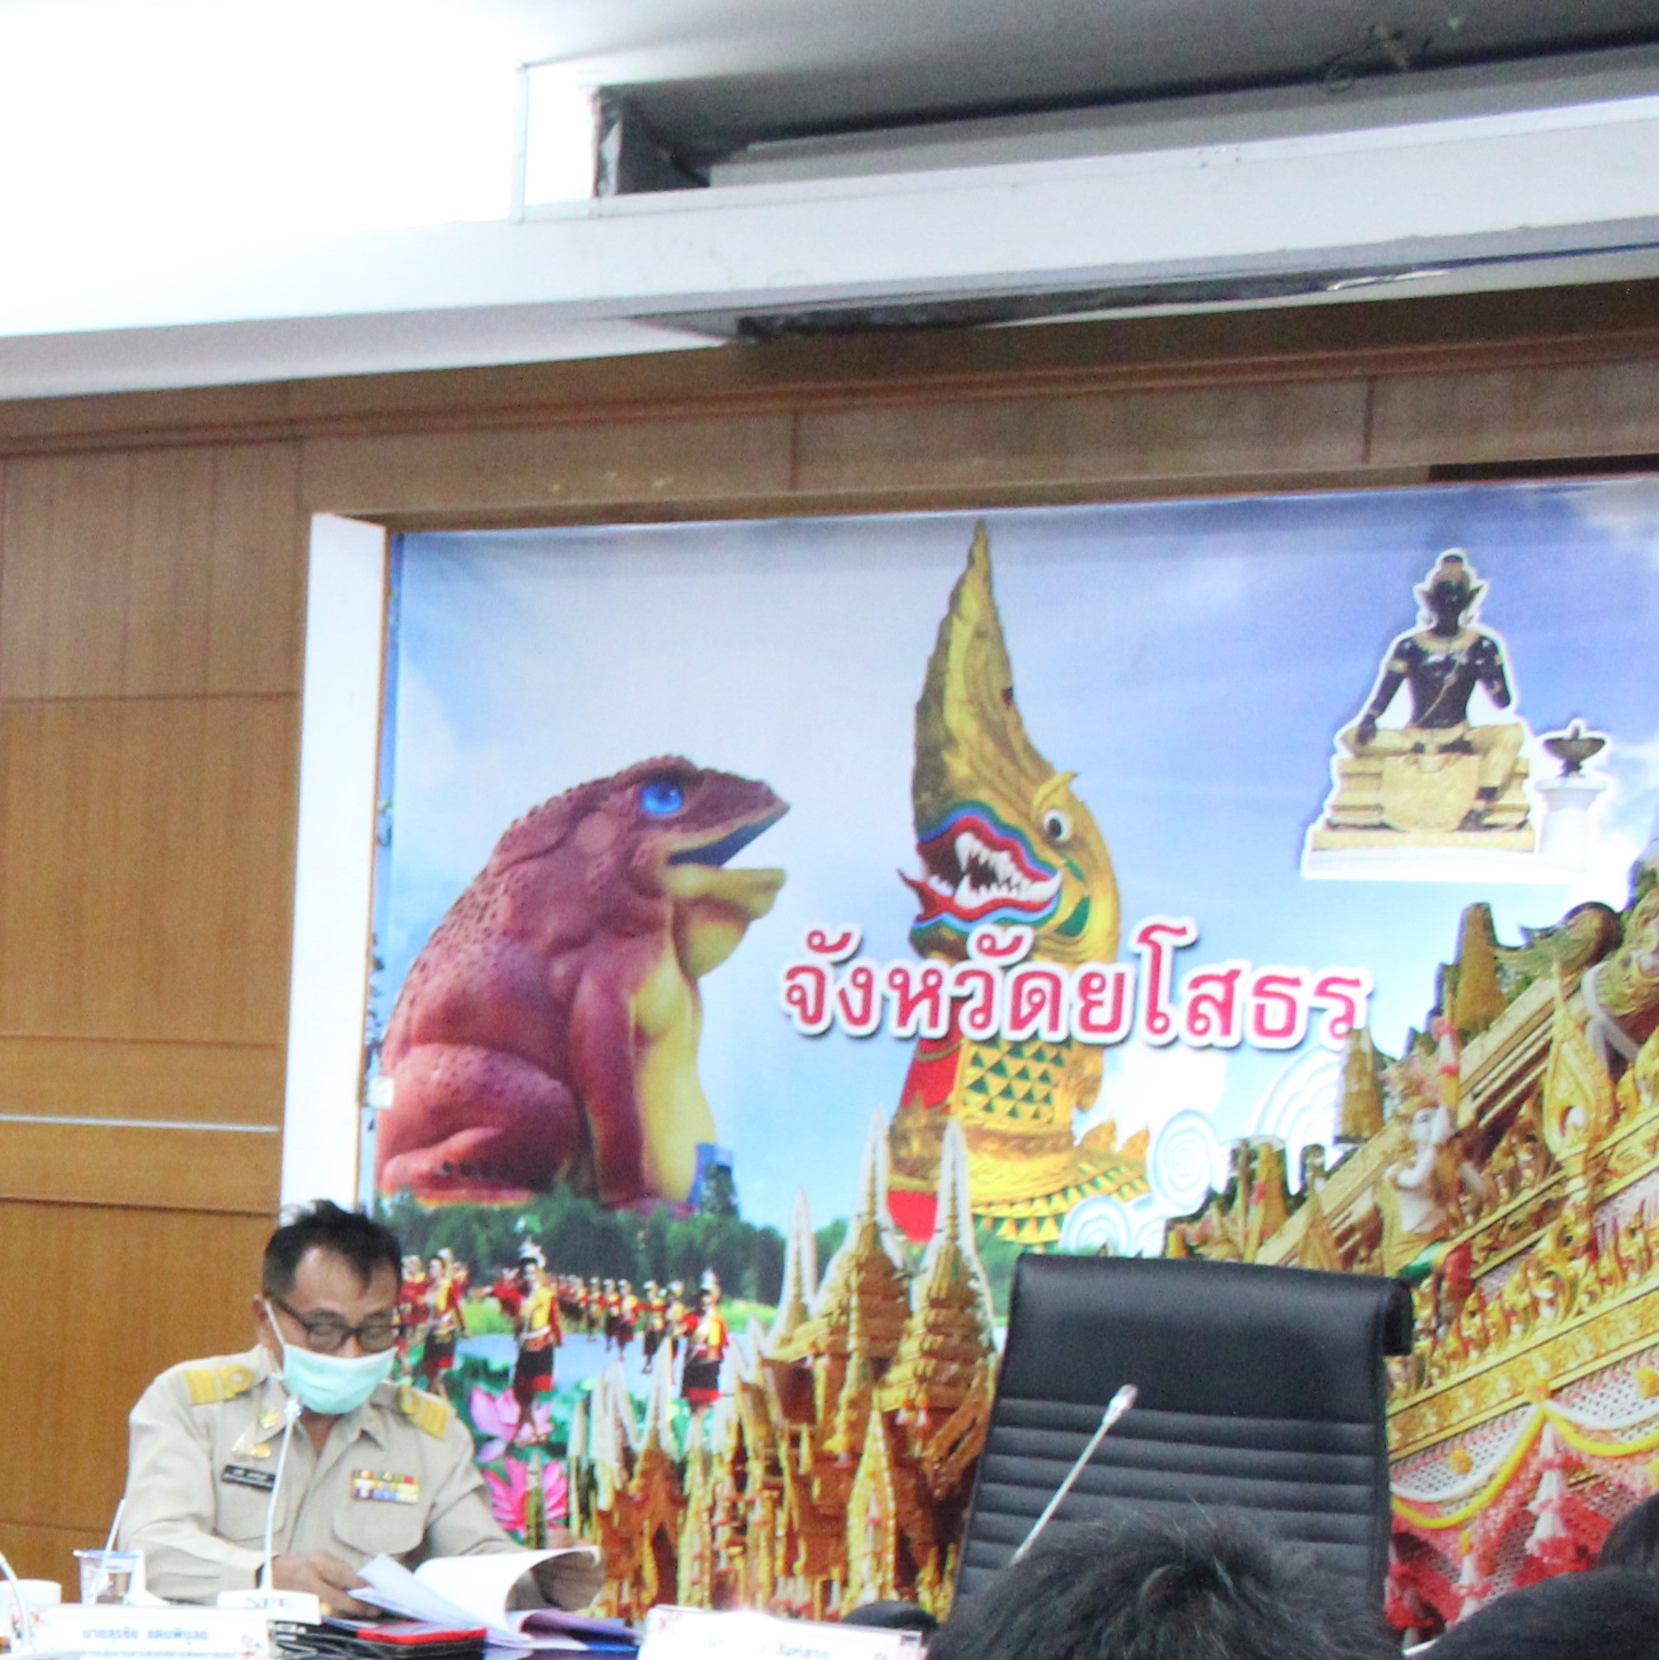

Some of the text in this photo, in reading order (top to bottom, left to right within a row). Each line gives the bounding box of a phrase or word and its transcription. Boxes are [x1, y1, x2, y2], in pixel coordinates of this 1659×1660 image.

[782, 922, 1367, 1044] จังหวัดยโสธร
